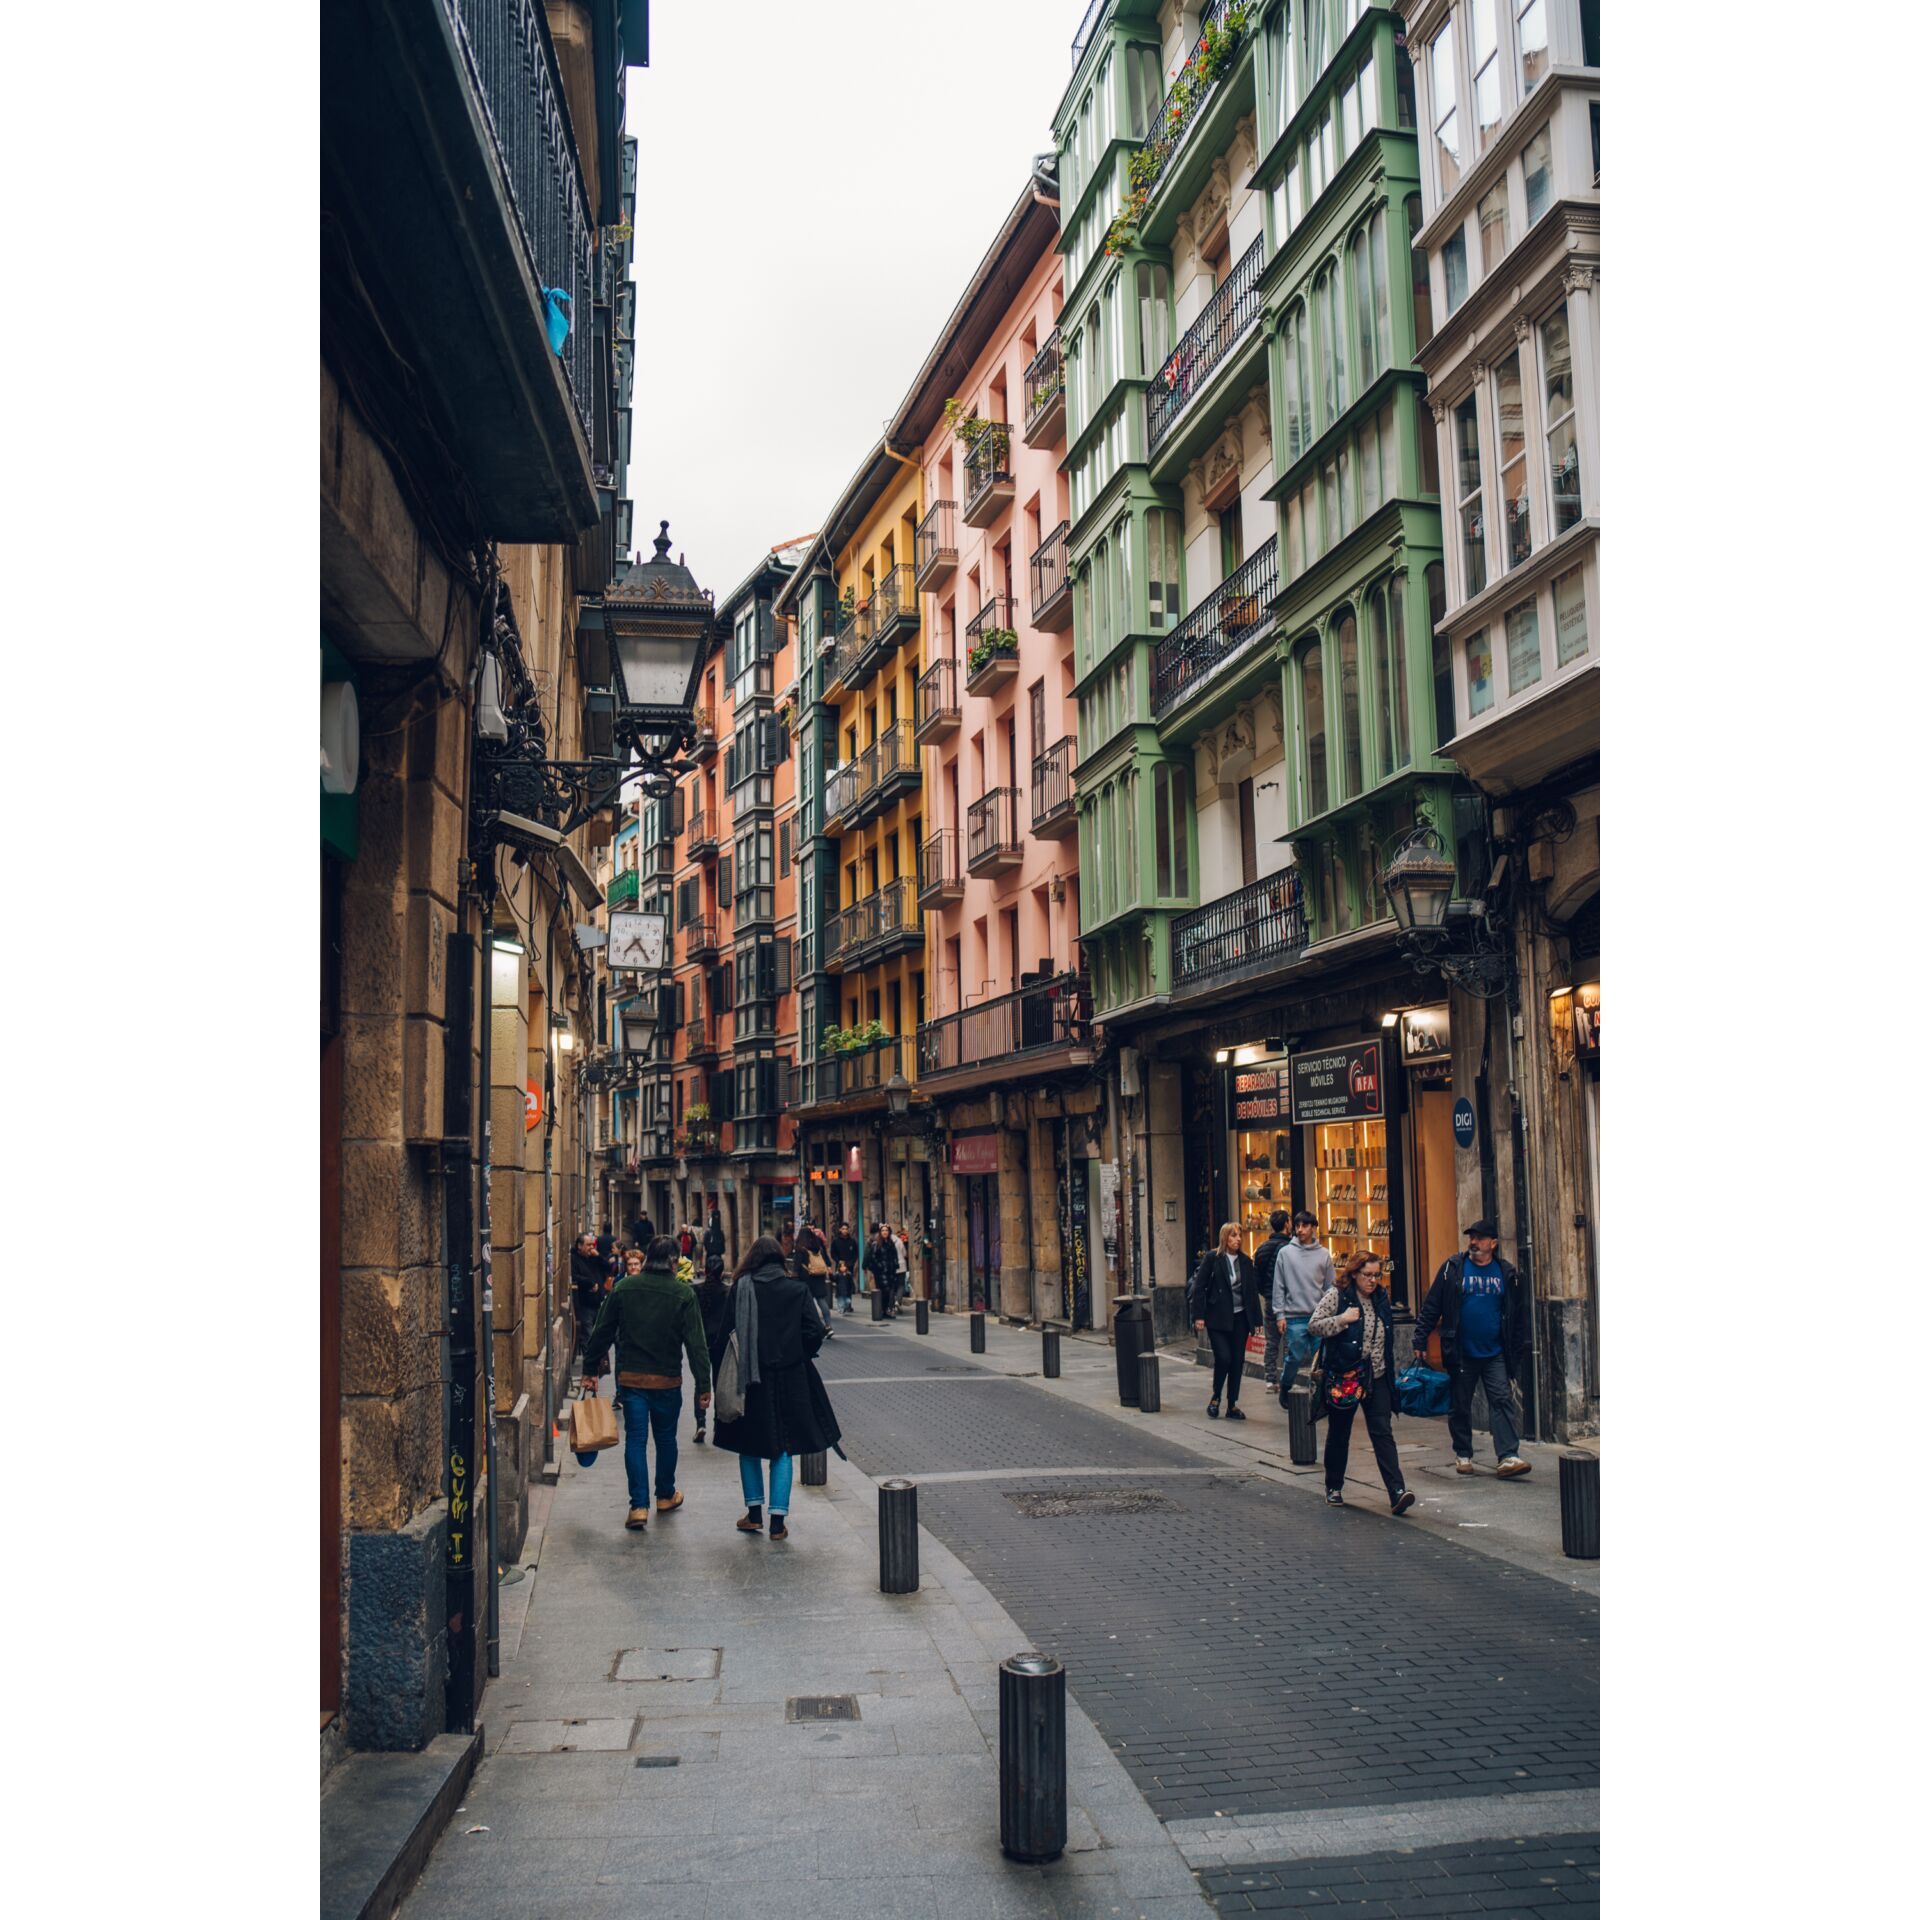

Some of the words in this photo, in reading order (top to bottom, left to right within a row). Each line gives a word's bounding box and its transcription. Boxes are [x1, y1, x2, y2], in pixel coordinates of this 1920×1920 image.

[1297, 1060, 1322, 1074] SERVICIO
[1322, 1056, 1347, 1070] TÉCNICO
[1236, 1067, 1277, 1093] REPARACIÓN
[1310, 1073, 1334, 1088] MÓVILES
[1237, 1101, 1246, 1119] DE
[1247, 1097, 1277, 1119] MÓVILES
[1301, 1109, 1313, 1118] MOBILE
[1313, 1107, 1331, 1117] TECHNICAL
[1331, 1106, 1346, 1115] SERVICE
[1455, 1112, 1472, 1127] DIGI
